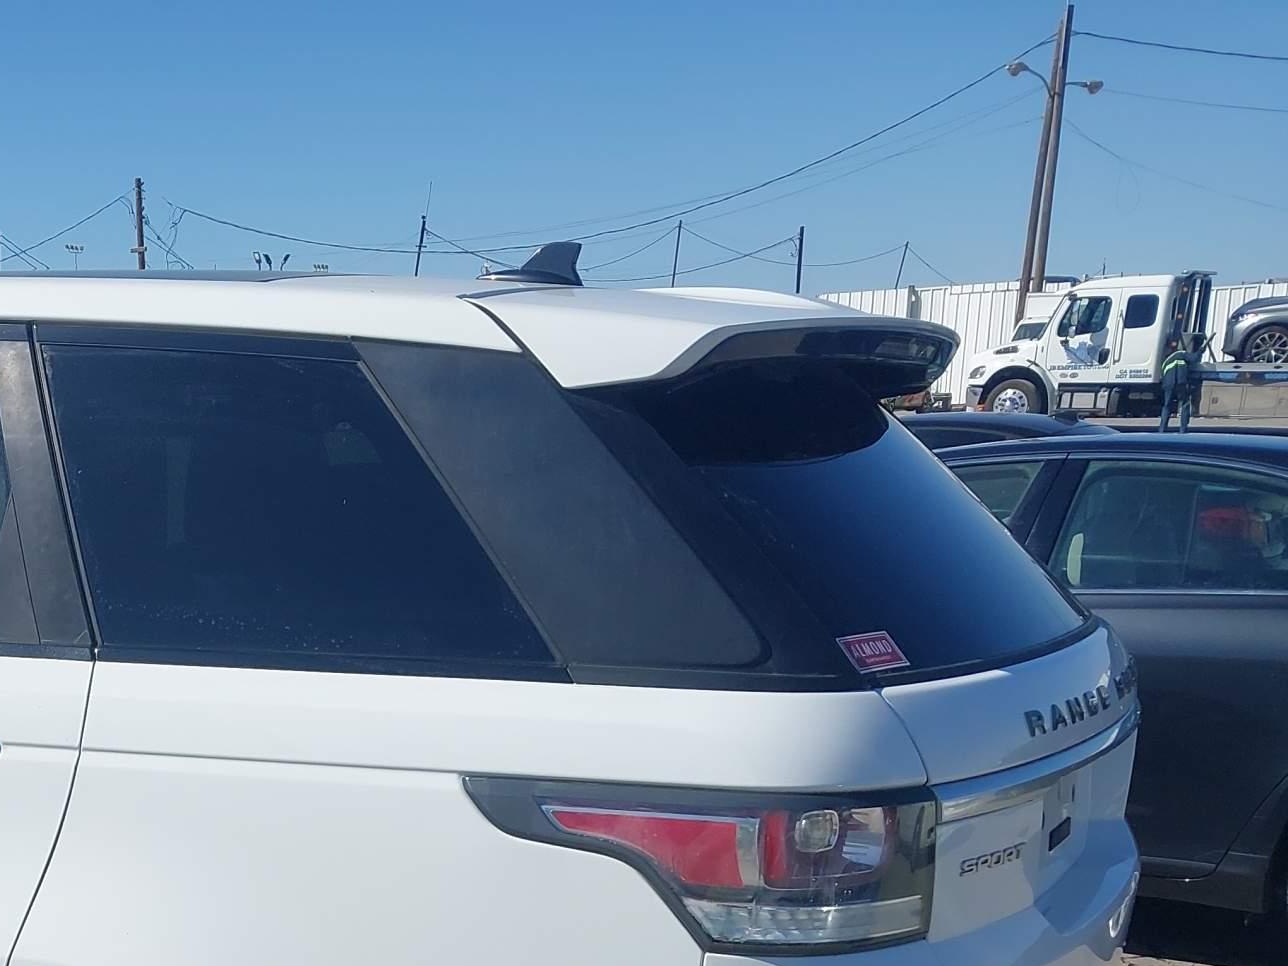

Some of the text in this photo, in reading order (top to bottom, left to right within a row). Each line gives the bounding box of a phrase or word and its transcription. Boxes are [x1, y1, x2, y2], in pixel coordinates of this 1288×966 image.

[850, 639, 893, 658] ALMOND
[1023, 684, 1111, 738] RANGE
[959, 841, 1027, 877] SPORT
